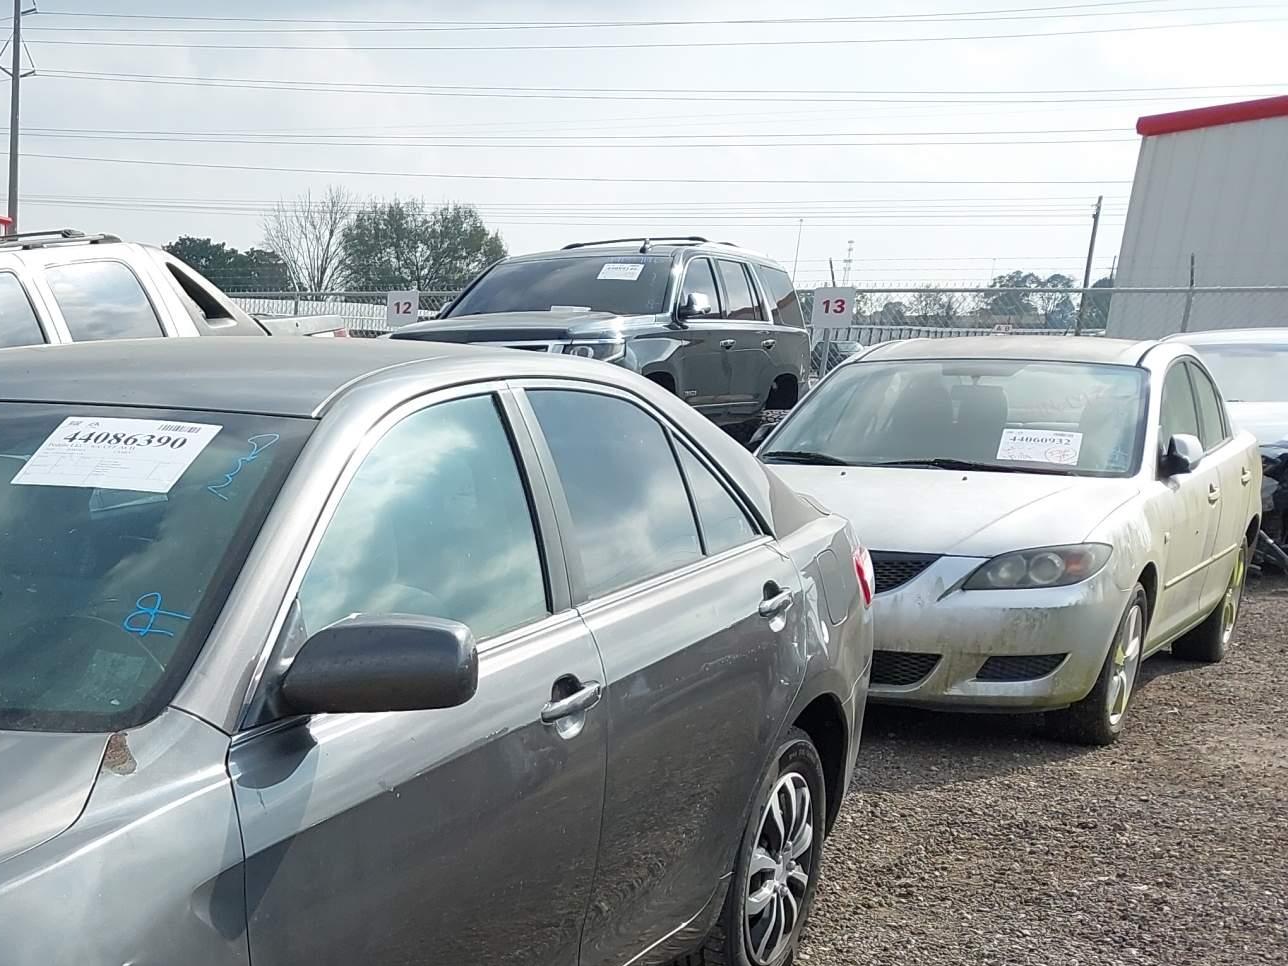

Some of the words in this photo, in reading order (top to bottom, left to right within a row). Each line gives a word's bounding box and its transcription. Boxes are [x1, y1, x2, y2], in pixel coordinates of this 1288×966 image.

[393, 301, 412, 315] 12
[822, 299, 846, 314] 13
[63, 431, 188, 450] 44086390
[1008, 436, 1072, 446] 44060932
